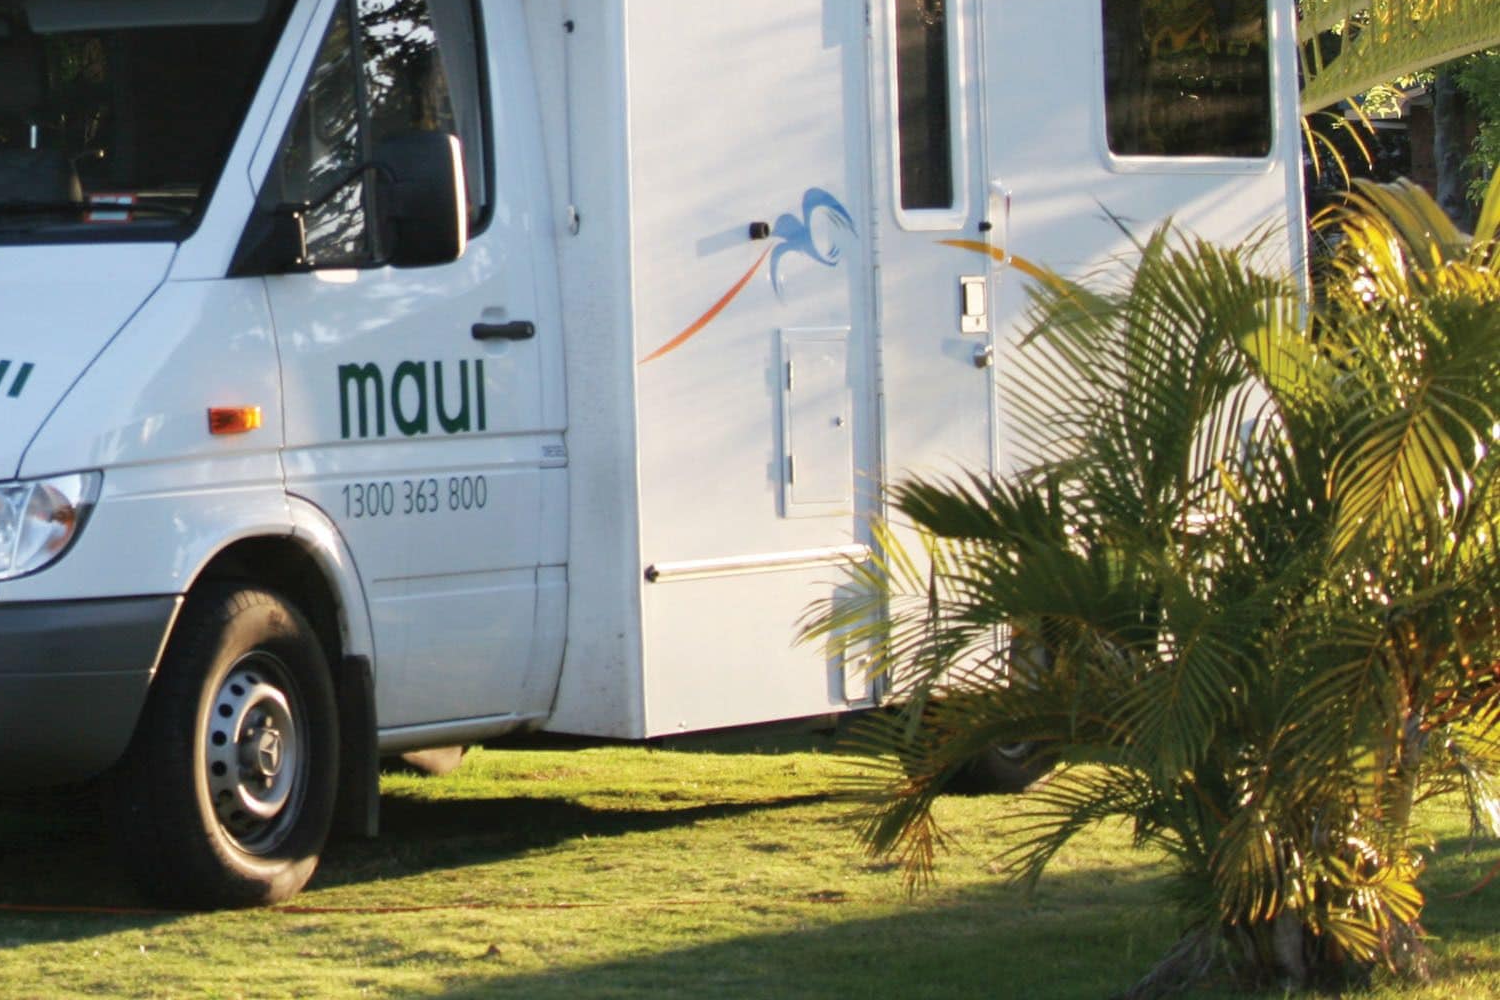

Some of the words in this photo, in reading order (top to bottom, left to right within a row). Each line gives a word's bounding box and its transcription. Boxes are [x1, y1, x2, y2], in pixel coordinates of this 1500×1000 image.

[337, 358, 487, 440] maui
[341, 481, 394, 519] 1300
[403, 478, 439, 515] 363
[449, 474, 488, 511] 800
